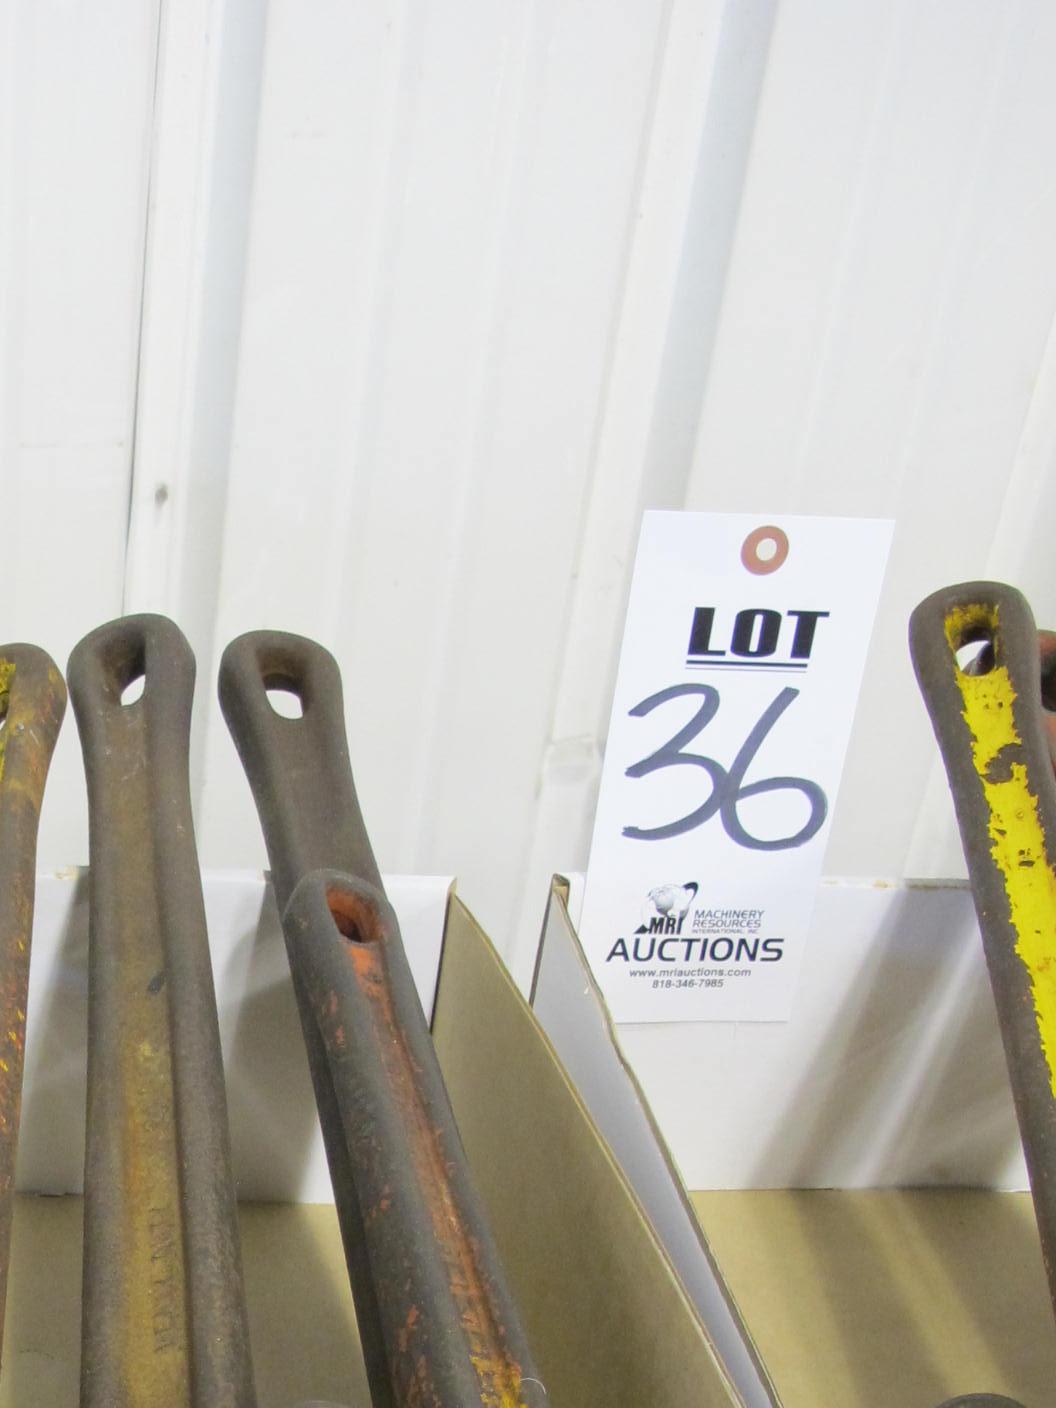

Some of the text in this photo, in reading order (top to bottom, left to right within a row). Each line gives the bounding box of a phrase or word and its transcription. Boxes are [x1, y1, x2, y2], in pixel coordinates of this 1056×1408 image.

[687, 606, 830, 659] LOT
[621, 682, 828, 851] 36
[694, 909, 765, 920] MACHINERY
[648, 917, 684, 935] MRI
[692, 919, 762, 929] RESOURCES
[605, 937, 785, 962] AUCTIONS
[628, 967, 752, 978] www.mriauctions.com
[652, 978, 724, 989] 818-346-7985
